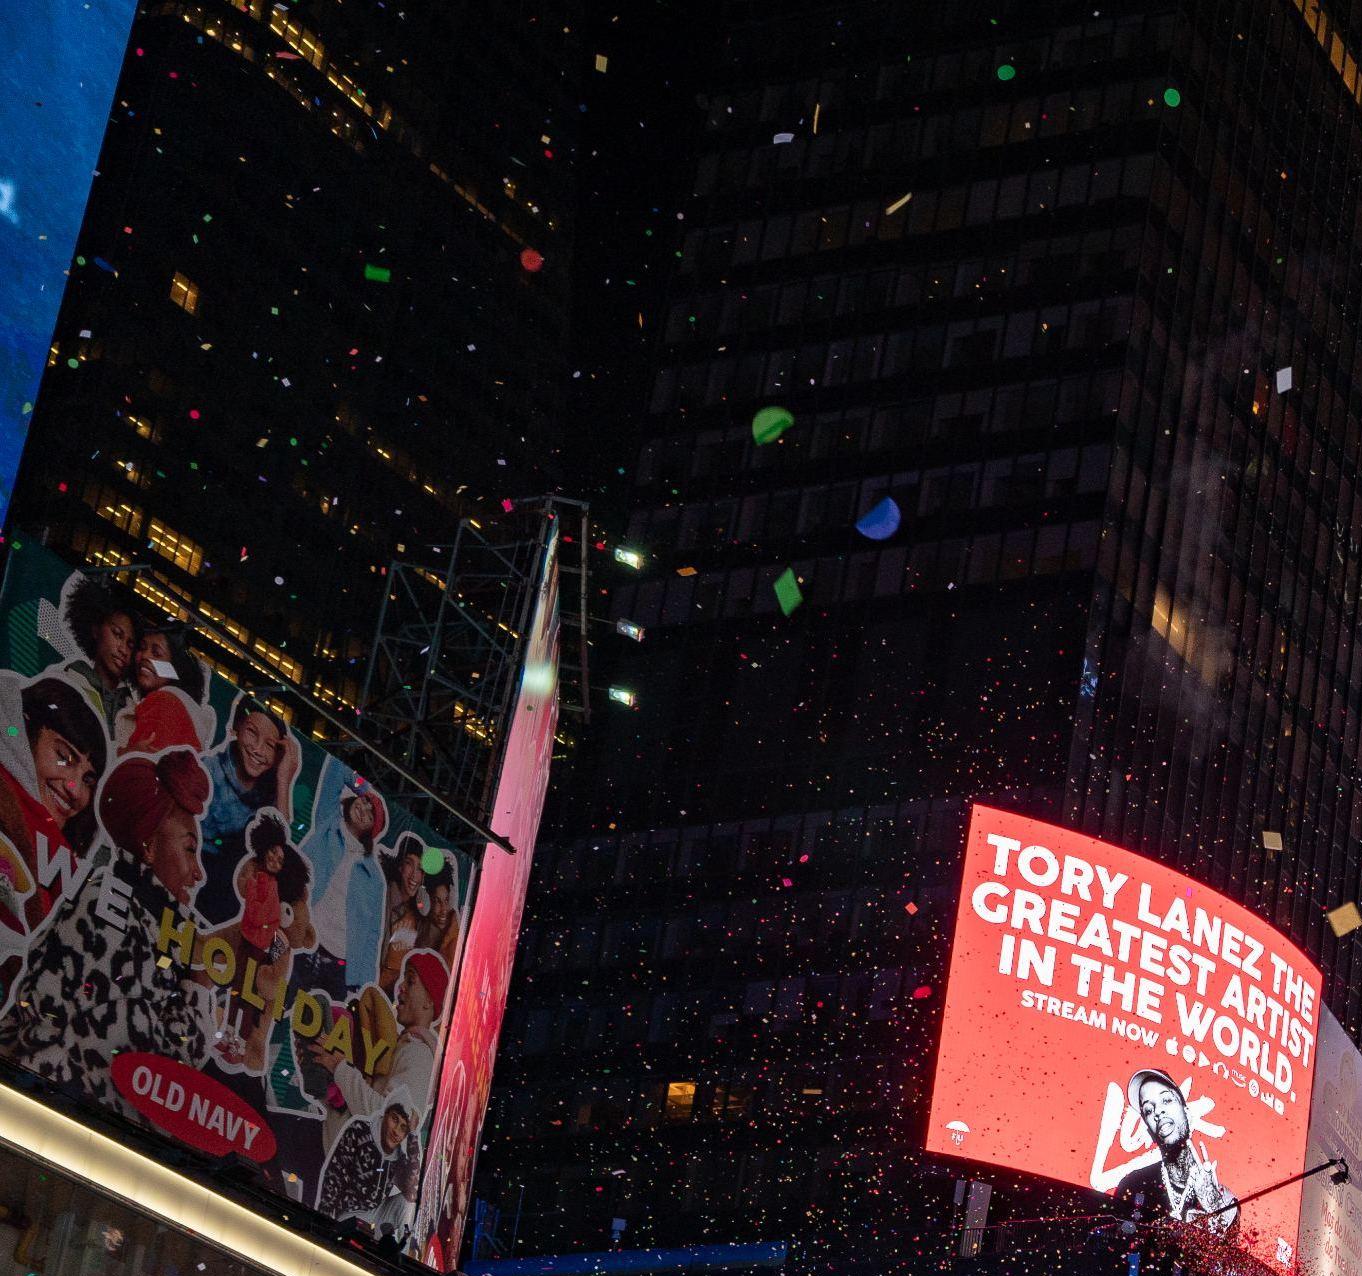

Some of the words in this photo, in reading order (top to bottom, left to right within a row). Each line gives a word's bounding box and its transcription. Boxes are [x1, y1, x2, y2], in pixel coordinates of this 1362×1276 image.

[36, 832, 139, 933] WE
[987, 832, 1129, 910] TORY
[1137, 883, 1265, 982] LANEZ
[1269, 951, 1316, 1026] THE
[156, 906, 396, 1077] HOLIDAY
[971, 882, 1215, 997] GREATEST
[1222, 975, 1315, 1068] ARTIST
[996, 935, 1057, 987] IN
[1071, 952, 1164, 1025] THE
[1175, 991, 1297, 1104] WORLD.
[1020, 989, 1107, 1032] STREAM
[1111, 1012, 1160, 1050] NOW
[130, 1064, 189, 1117] OLD
[187, 1092, 261, 1151] NAVY
